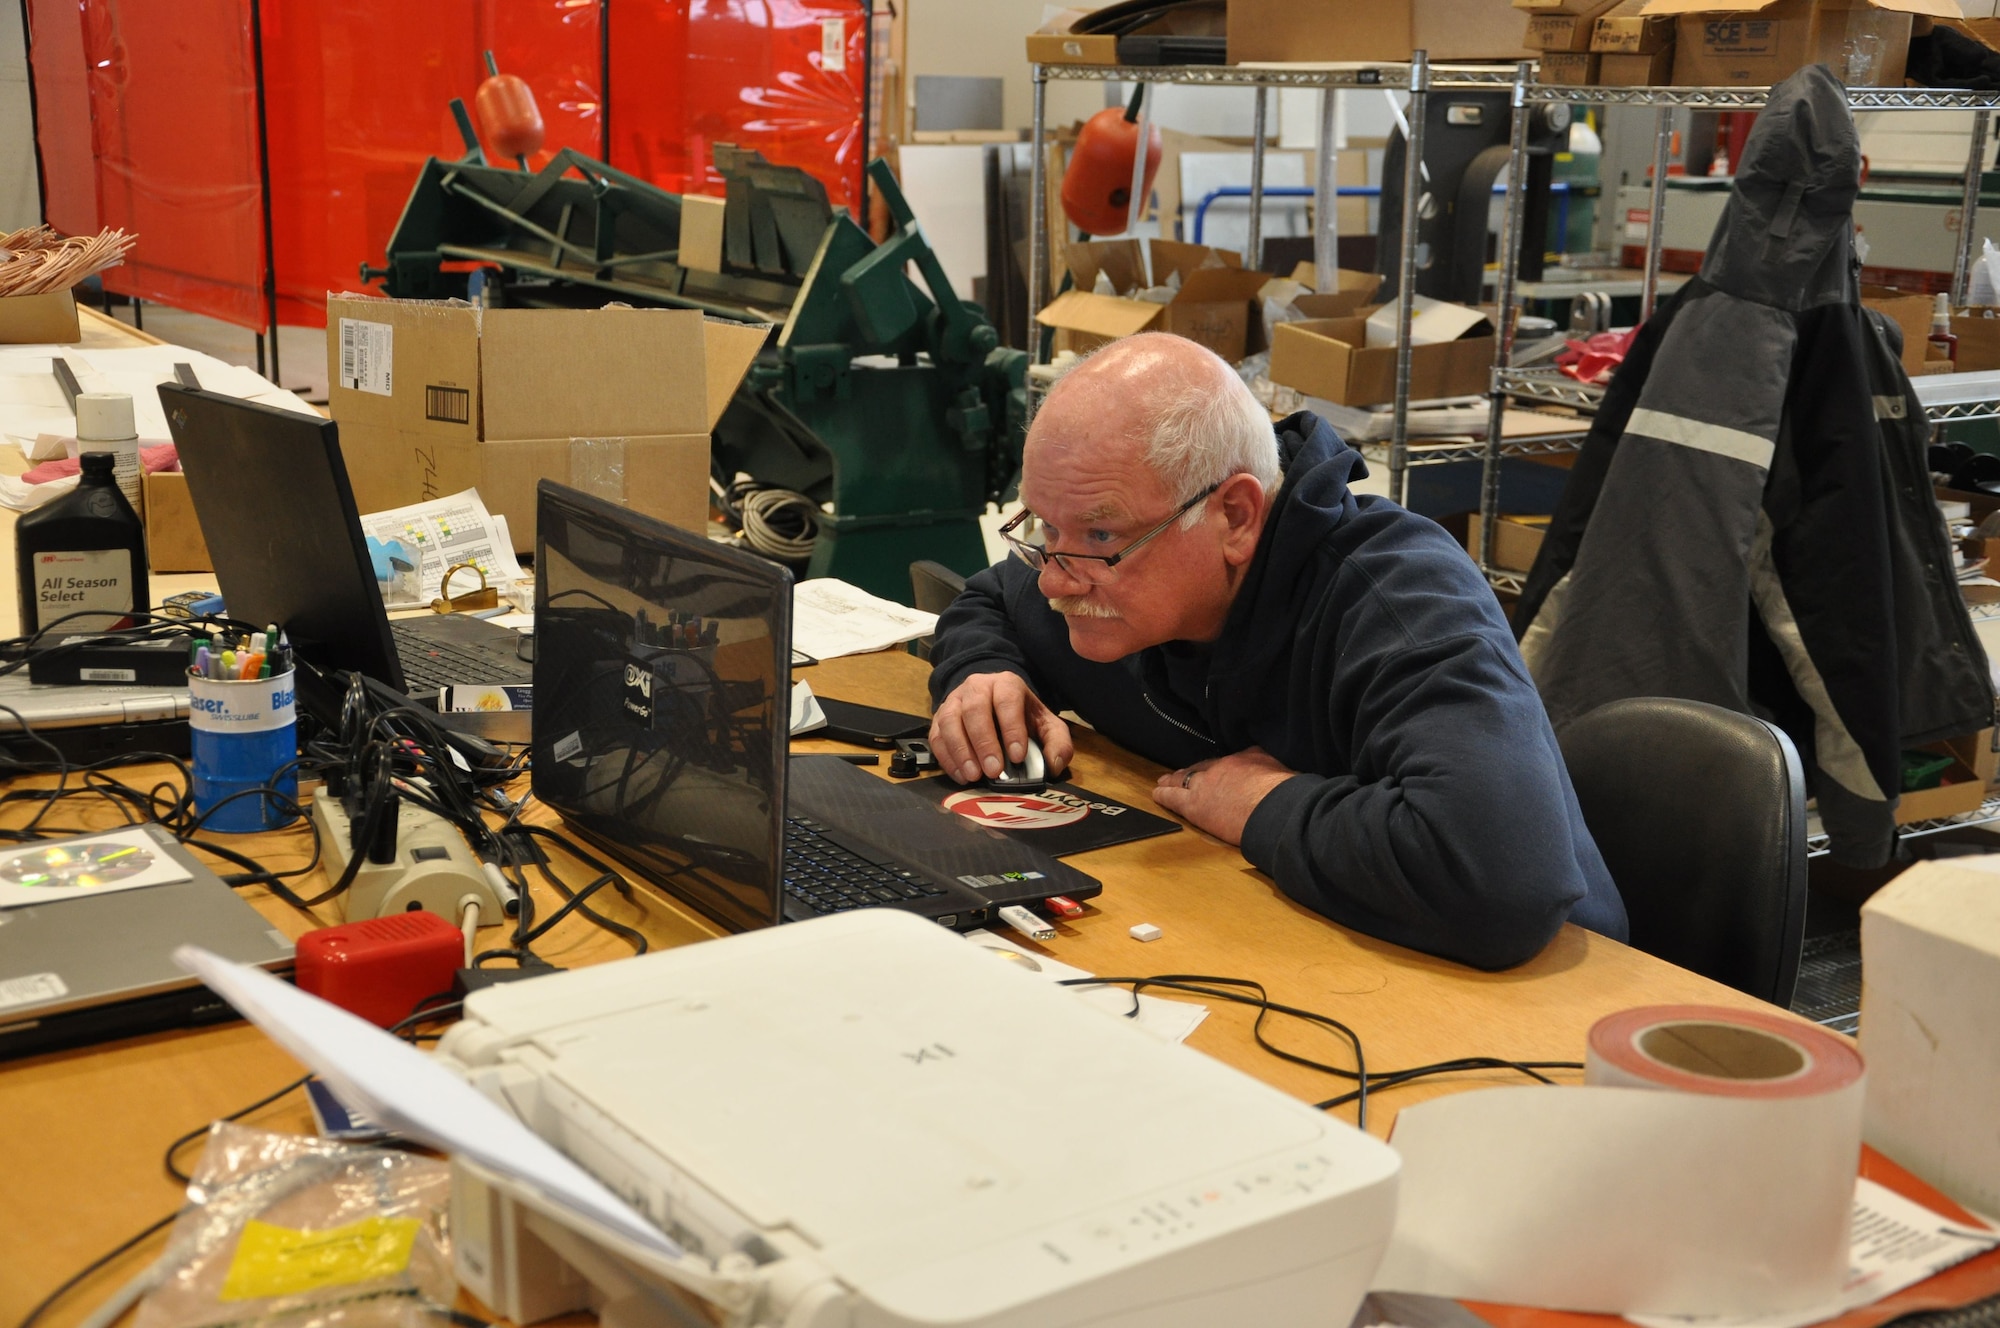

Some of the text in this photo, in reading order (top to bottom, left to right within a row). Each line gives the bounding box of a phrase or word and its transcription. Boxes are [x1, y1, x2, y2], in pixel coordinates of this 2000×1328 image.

[1704, 21, 1742, 45] SCE
[42, 577, 117, 589] All Season
[40, 590, 85, 602] Select
